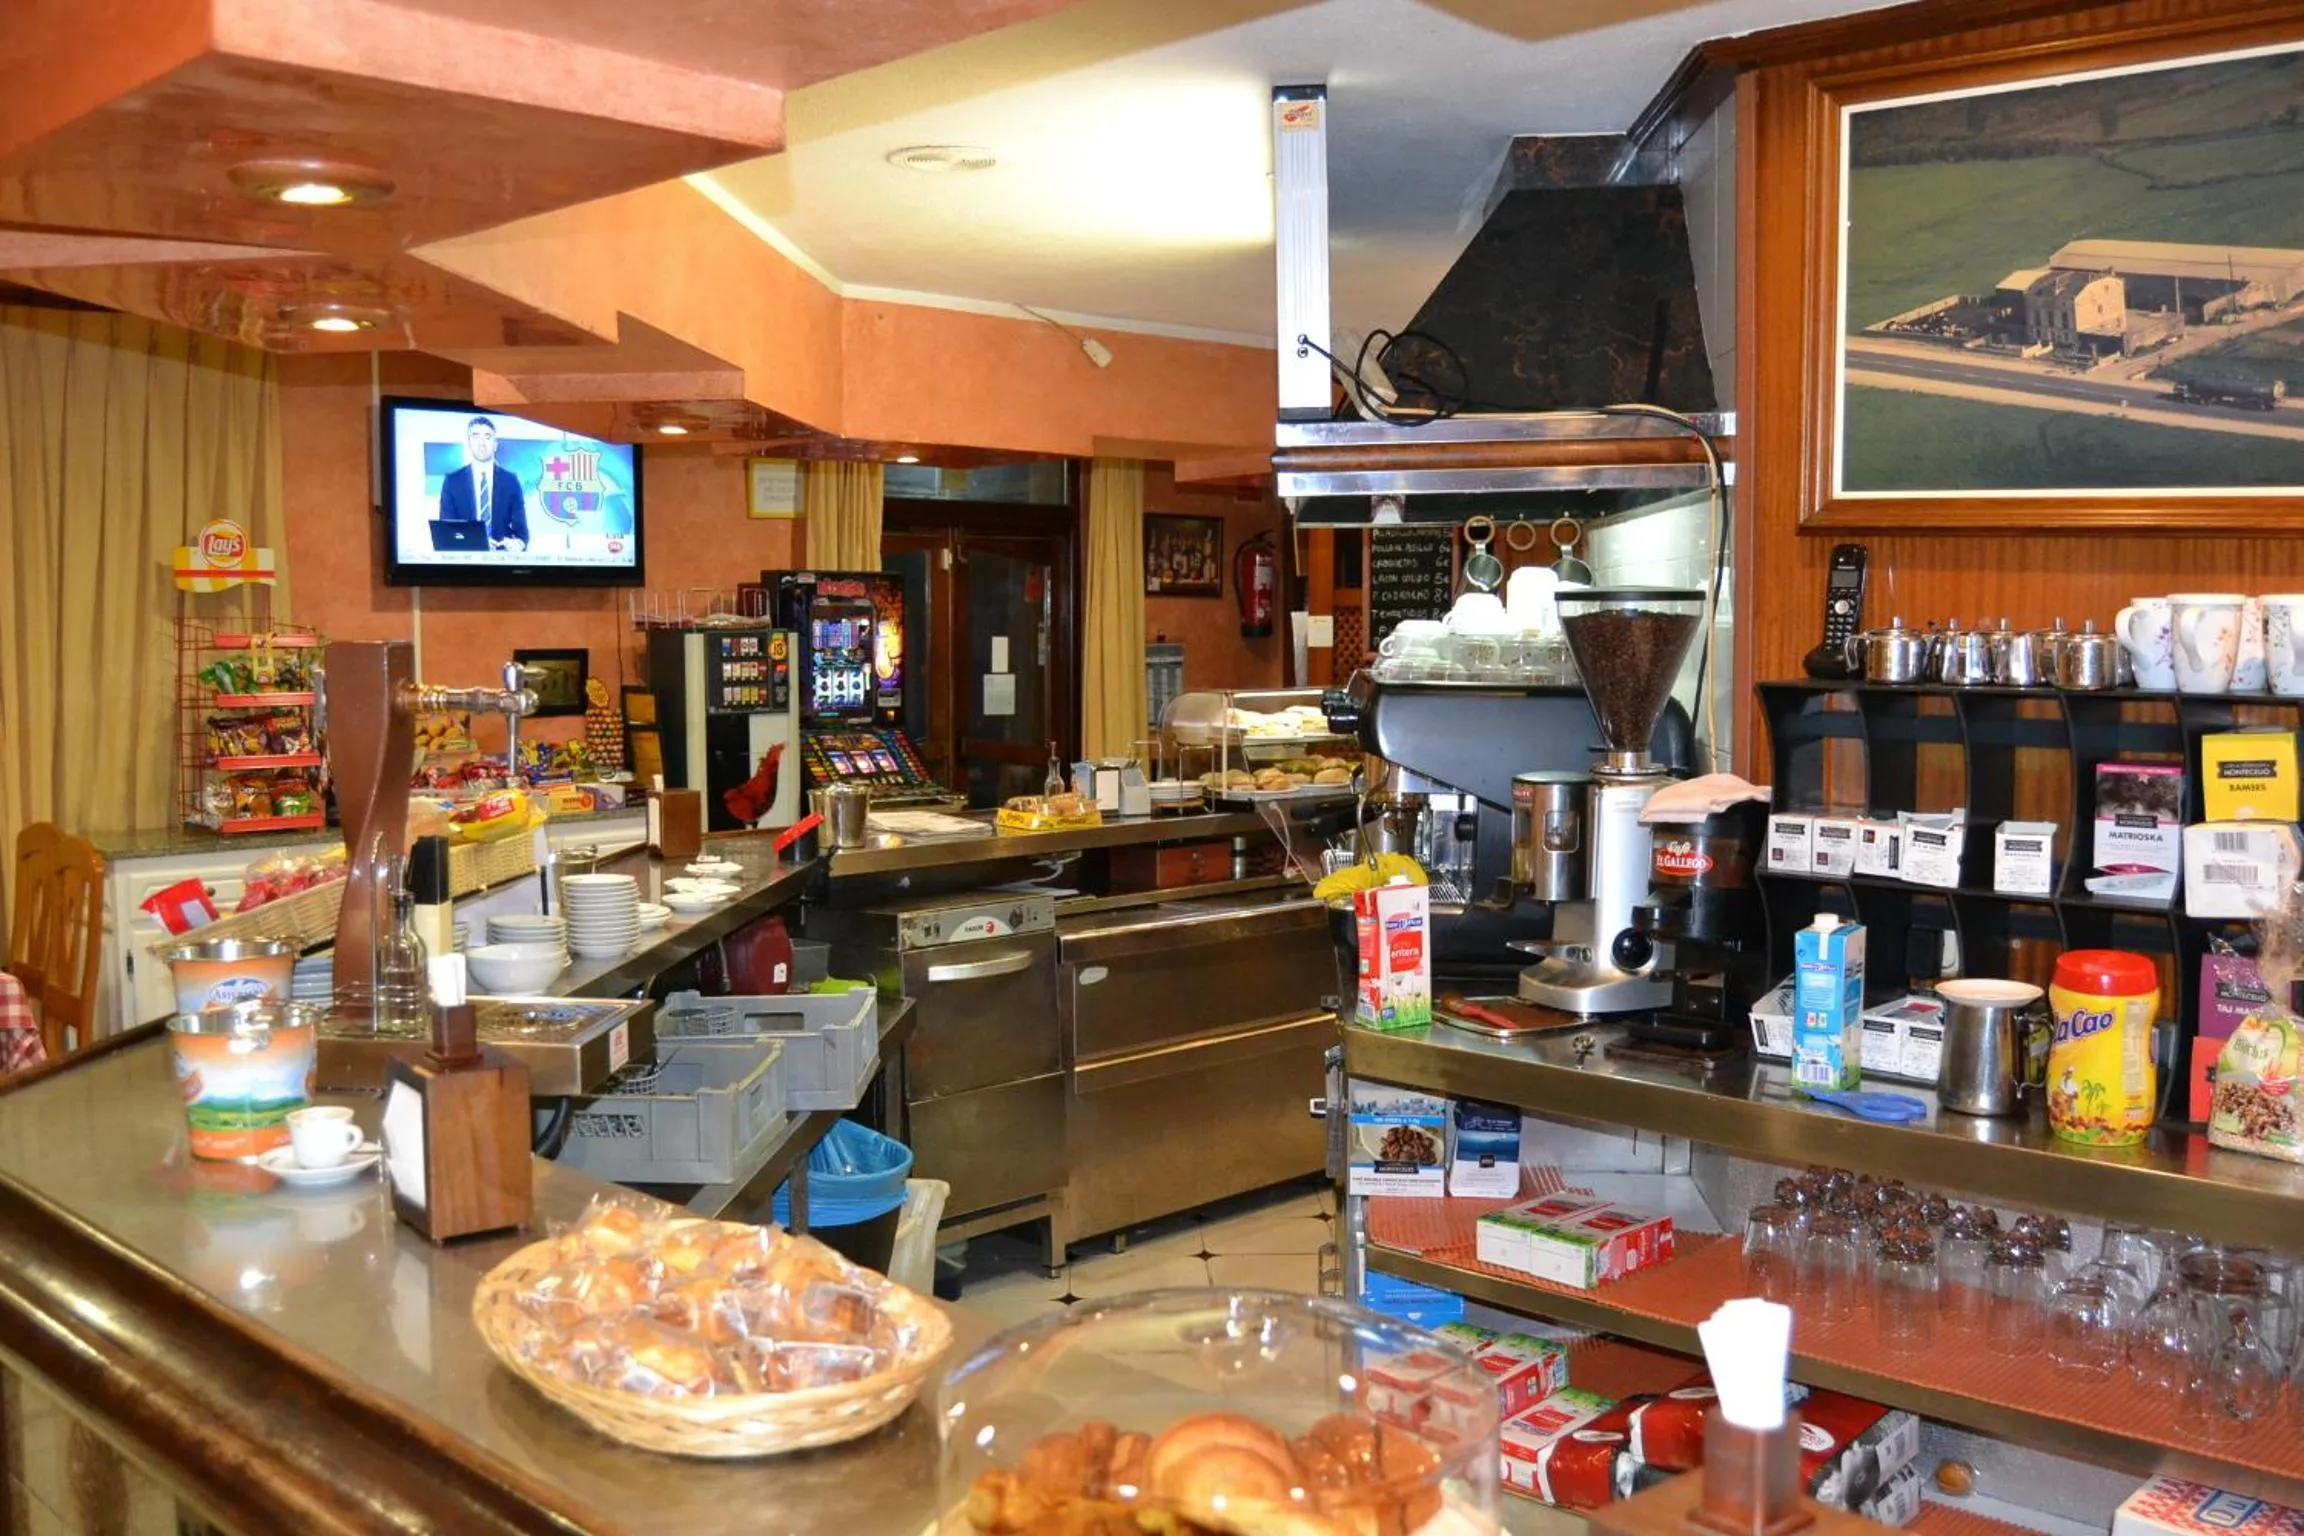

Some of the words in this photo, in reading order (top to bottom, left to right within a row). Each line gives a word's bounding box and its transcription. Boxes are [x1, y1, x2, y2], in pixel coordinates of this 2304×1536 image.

[2108, 831, 2164, 843] MATRIOSKA
[1664, 854, 1706, 868] GALLEGO
[1390, 947, 1420, 959] entera
